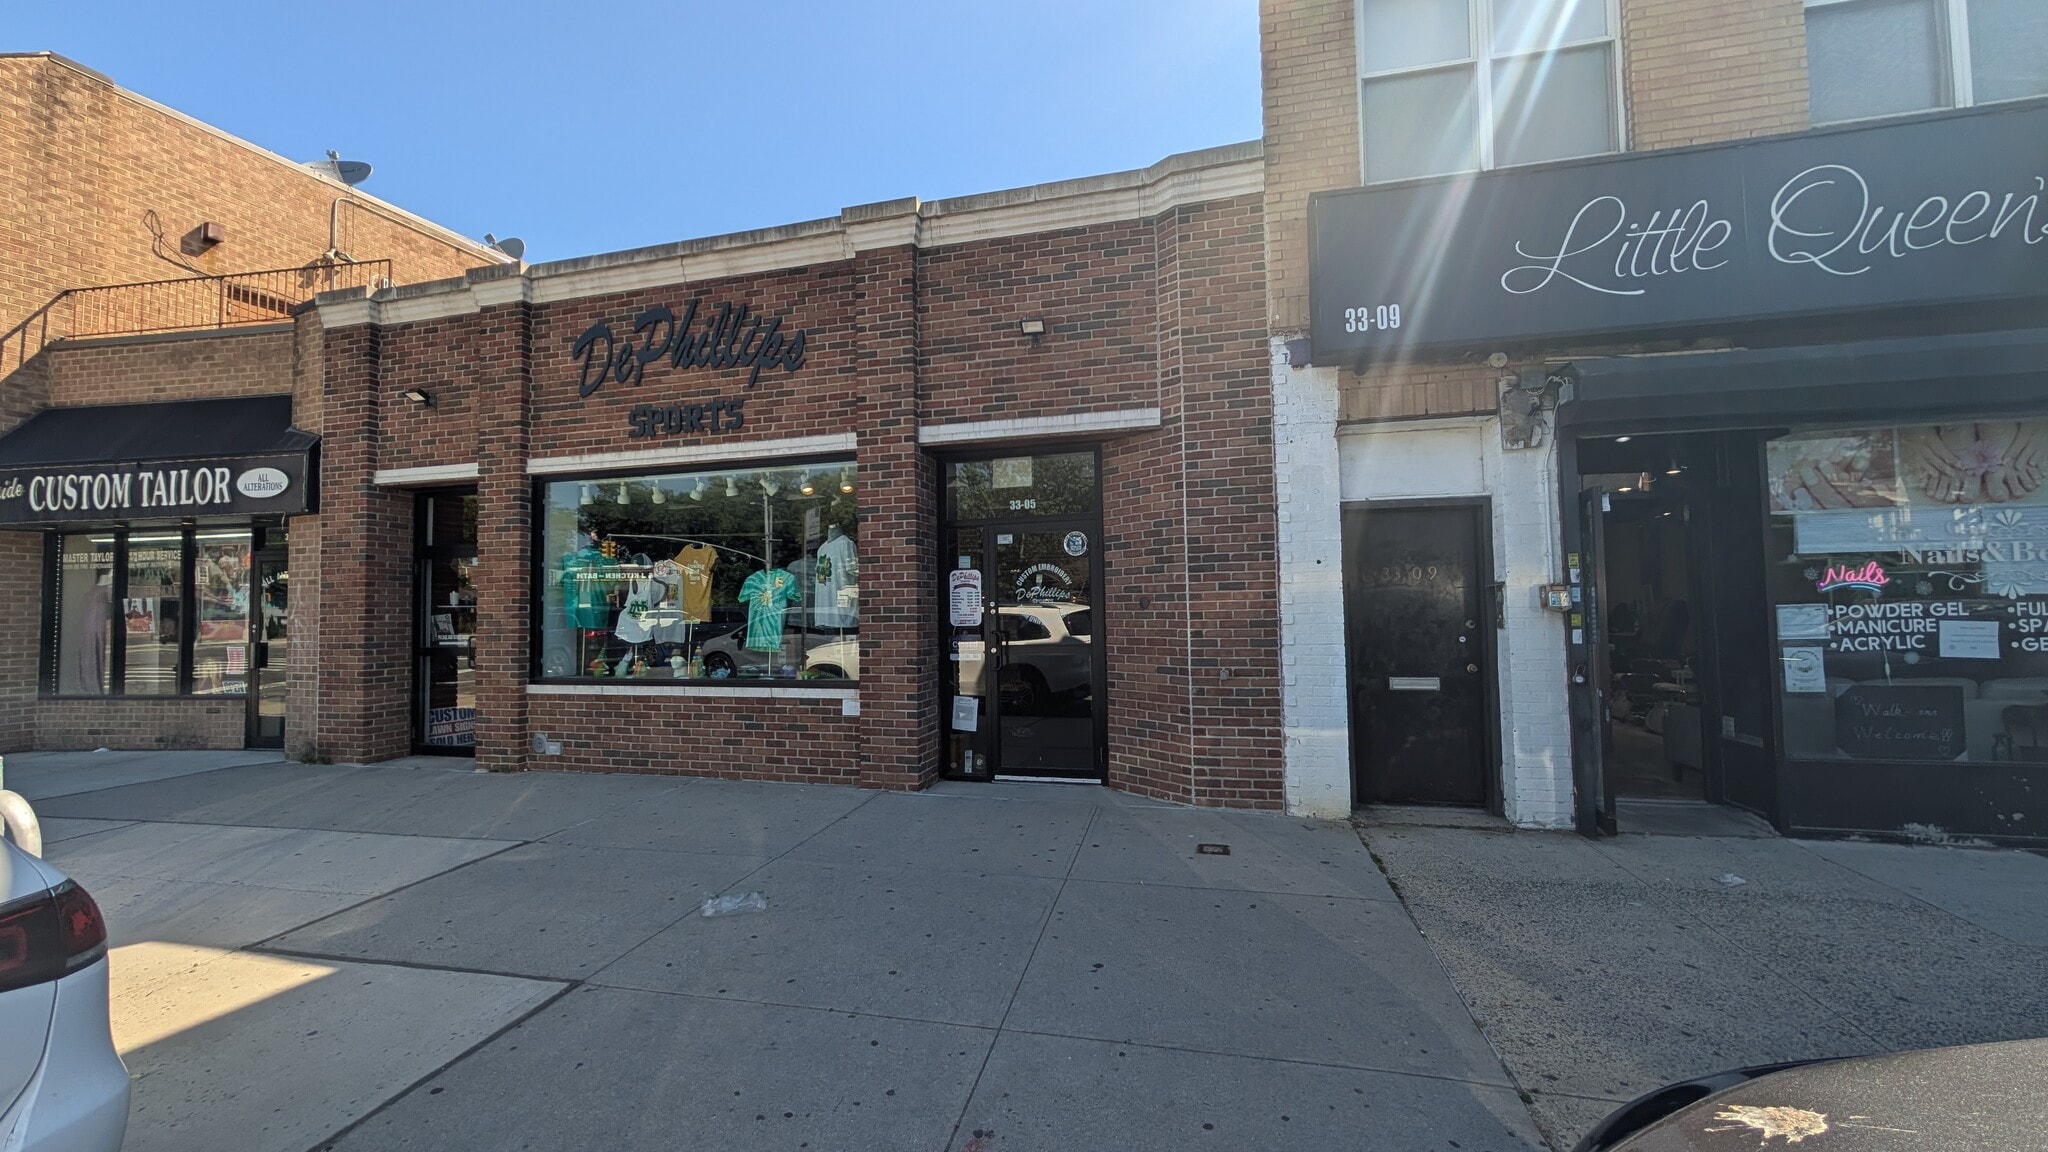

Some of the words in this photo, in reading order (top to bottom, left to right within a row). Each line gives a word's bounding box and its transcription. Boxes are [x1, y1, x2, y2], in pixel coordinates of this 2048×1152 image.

[1501, 195, 1732, 296] Little
[1768, 164, 2048, 276] Queen'
[1344, 303, 1401, 333] 33-09
[572, 300, 806, 398] DePhillips
[628, 400, 745, 438] SPORTS
[258, 473, 269, 482] ALL
[0, 477, 24, 499] ide
[29, 473, 131, 512] CUSTOM
[138, 467, 231, 507] TAILOR
[243, 482, 283, 491] ALTERATIONS
[1009, 499, 1036, 510] 33-05
[62, 553, 89, 562] MASTER
[157, 550, 182, 560] SERVICE
[1016, 565, 1038, 586] CUSTOM
[1038, 563, 1073, 586] EMBROIDERY
[1819, 561, 1890, 588] Nails
[1015, 586, 1071, 602] DePhillips
[1835, 603, 1923, 618] POWDER
[1930, 602, 1969, 616] GEL
[1837, 618, 1937, 634] MANICURE
[1840, 635, 1926, 651] ACRYLIC
